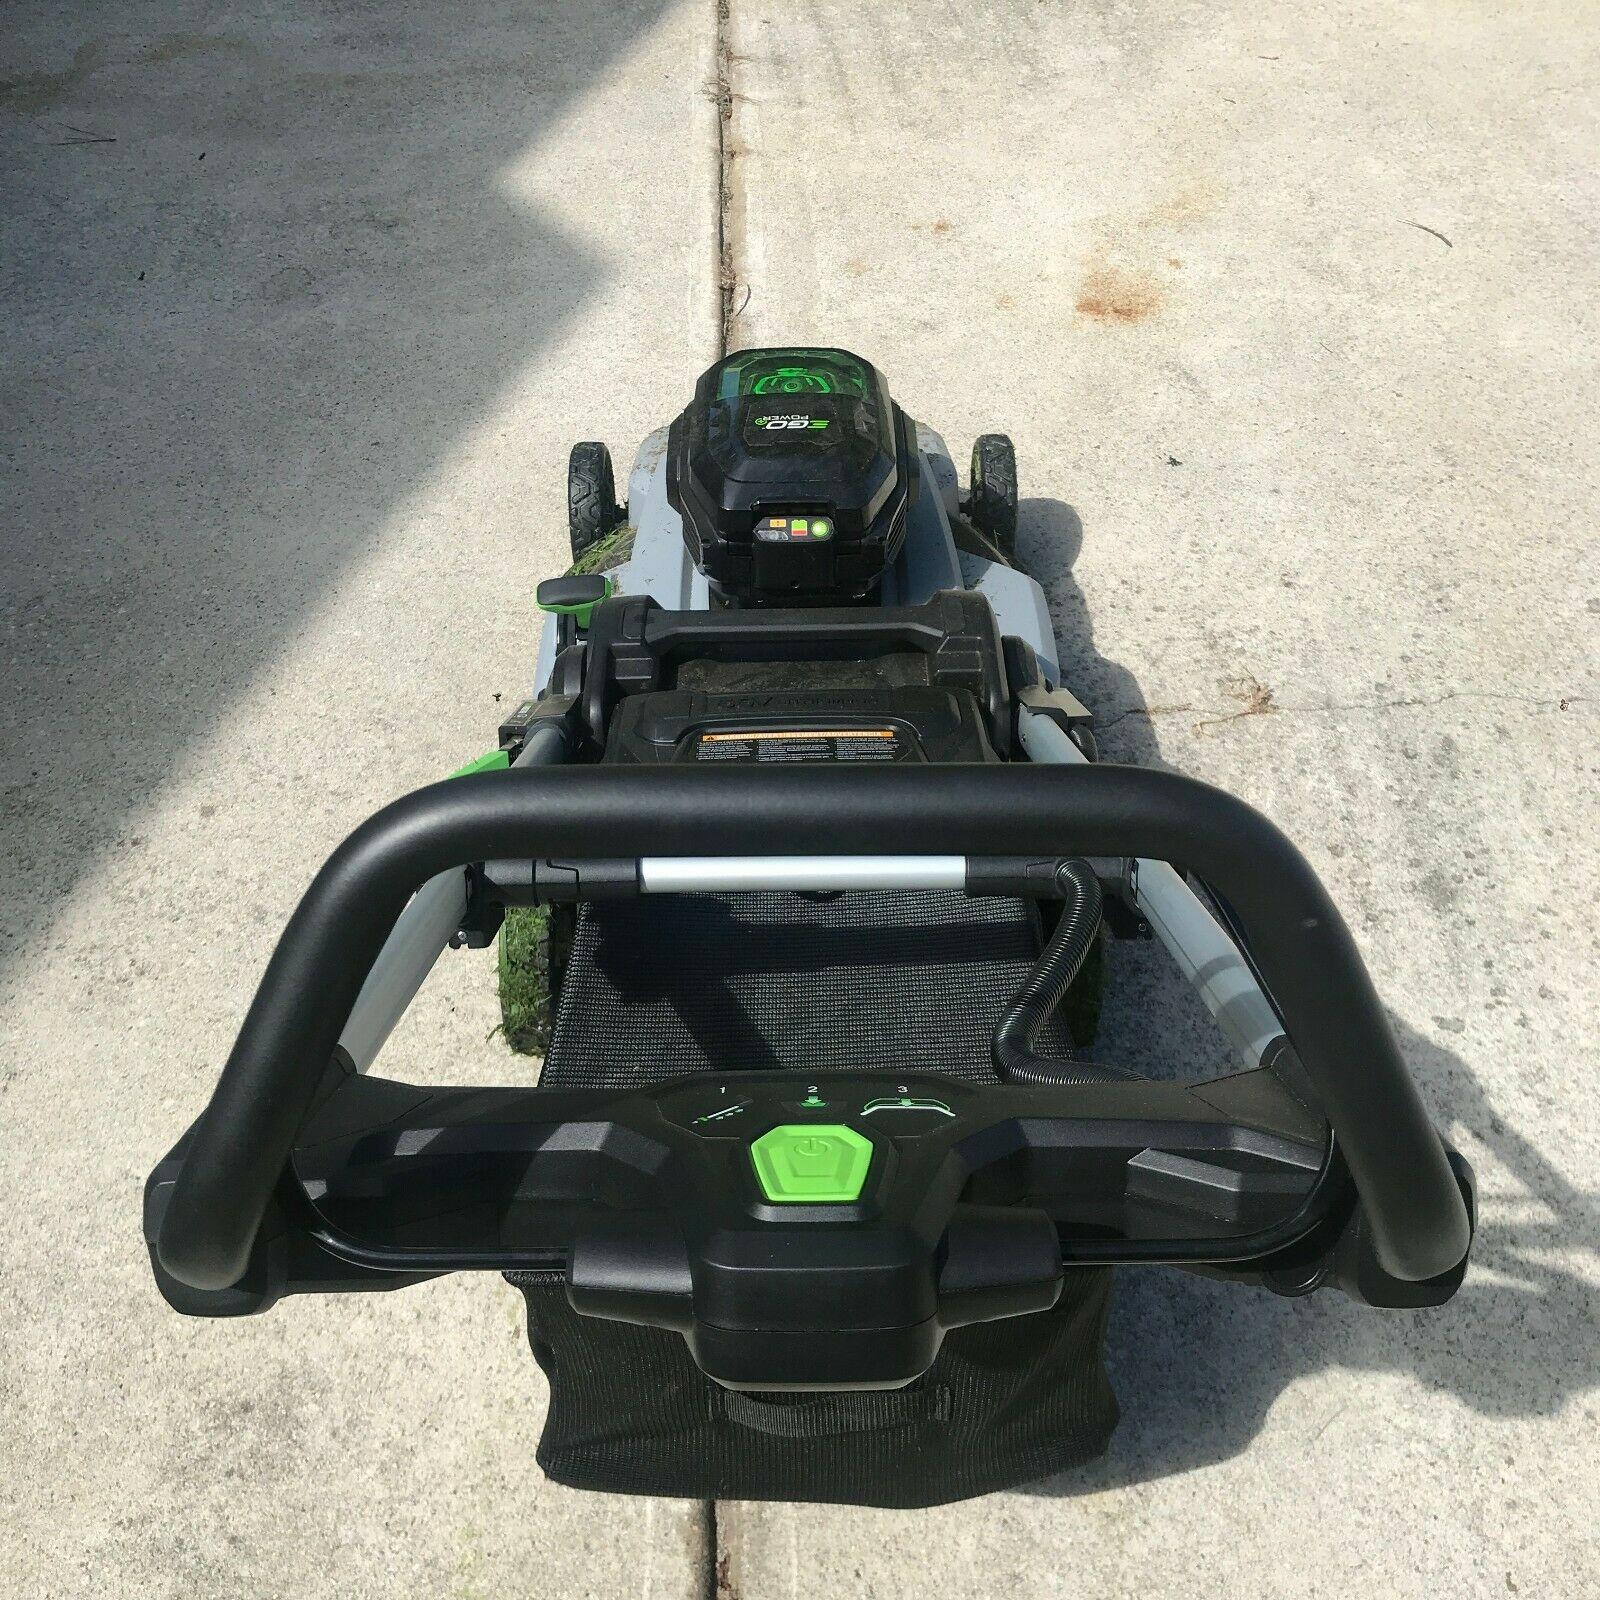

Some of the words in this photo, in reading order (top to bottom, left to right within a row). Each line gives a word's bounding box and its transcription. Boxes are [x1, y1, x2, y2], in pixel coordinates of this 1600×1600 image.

[766, 420, 830, 430] EGO
[720, 1086, 726, 1094] 1
[807, 1085, 818, 1093] 2
[898, 1085, 908, 1093] 3
